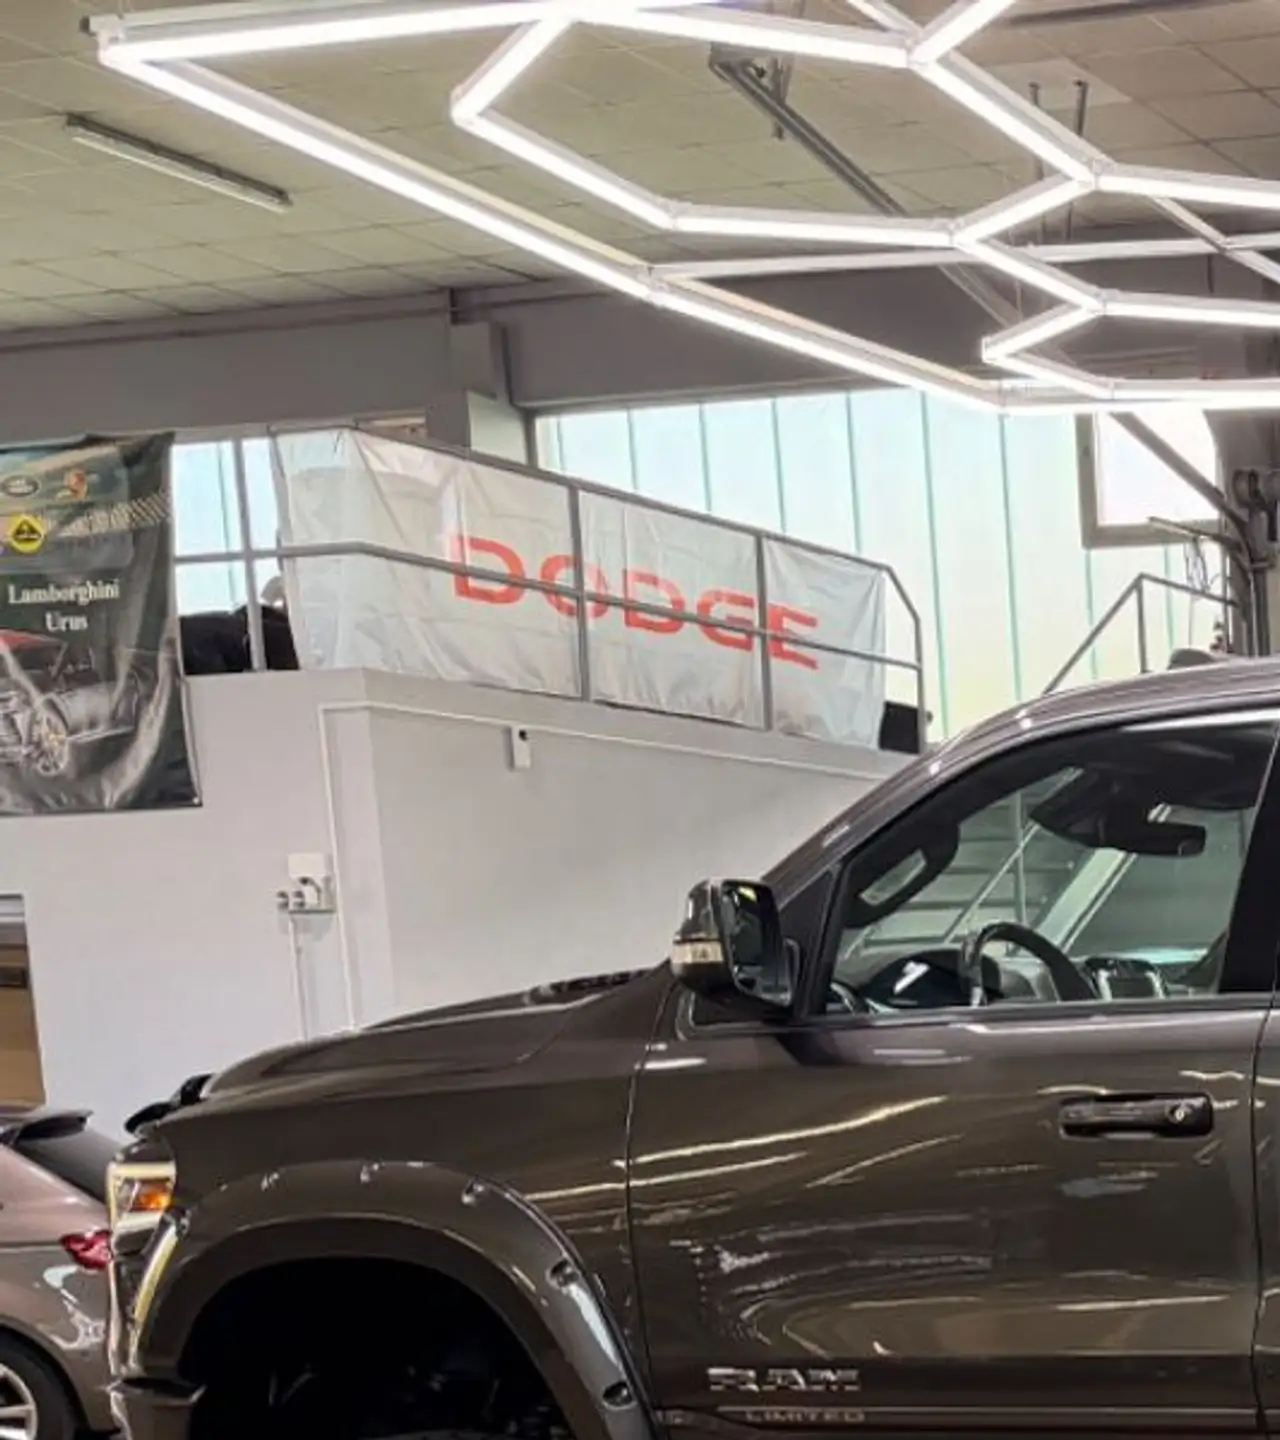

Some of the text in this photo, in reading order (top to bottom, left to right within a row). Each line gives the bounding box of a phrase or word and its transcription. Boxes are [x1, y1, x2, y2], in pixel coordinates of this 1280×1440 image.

[8, 578, 120, 604] Lamborghini
[453, 534, 819, 671] DODGE
[45, 610, 89, 631] Urus
[706, 1367, 860, 1391] RAM
